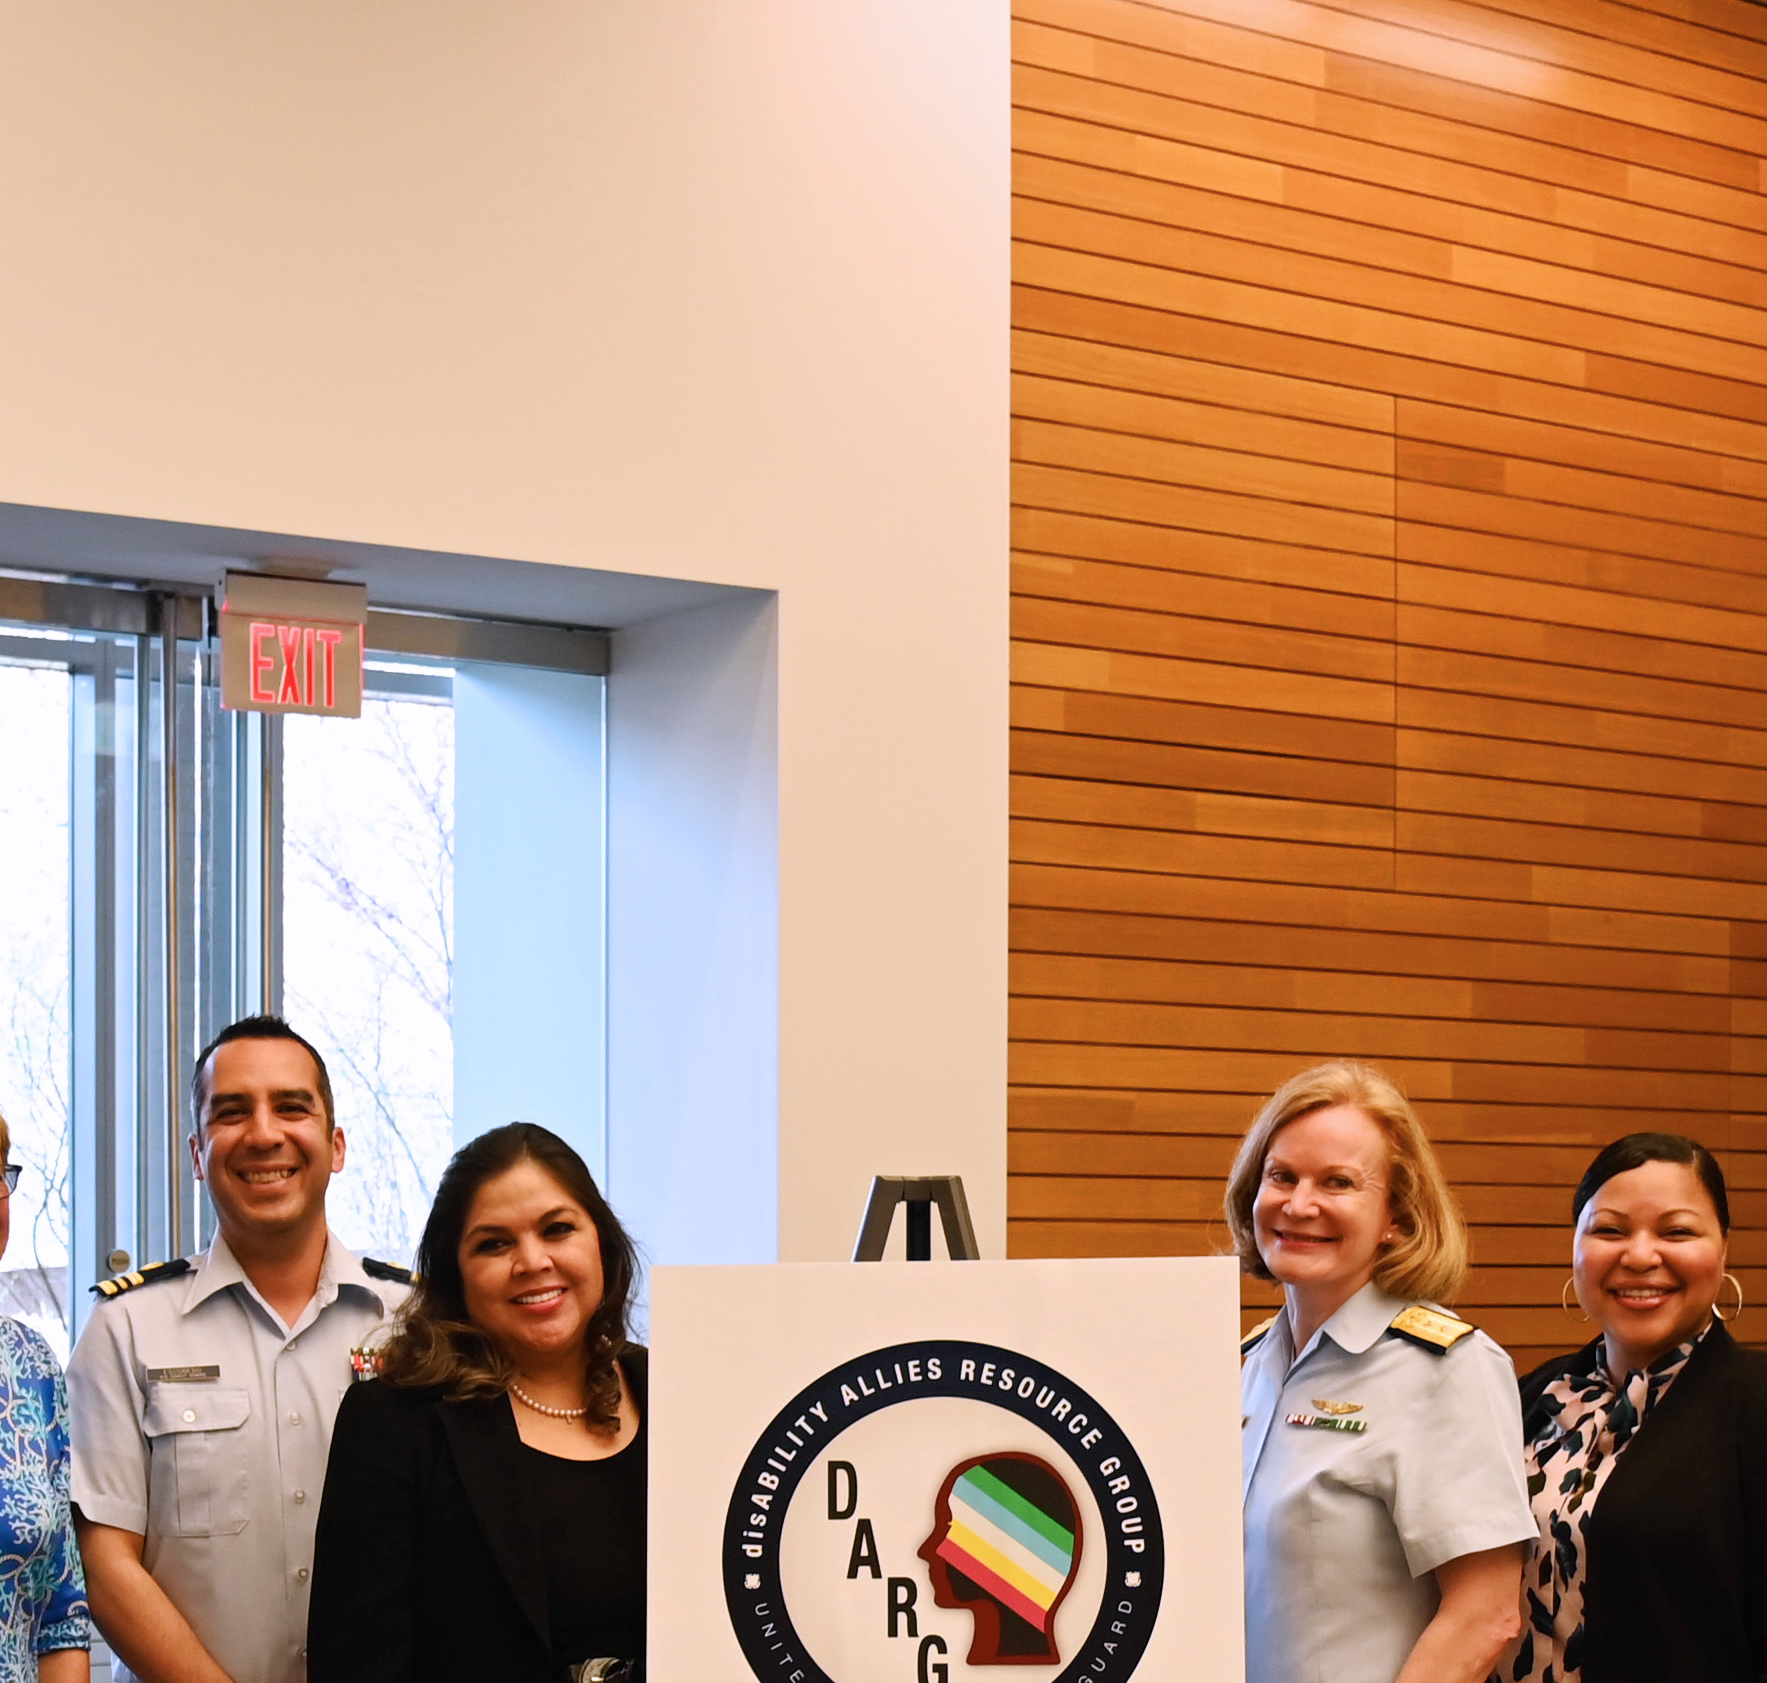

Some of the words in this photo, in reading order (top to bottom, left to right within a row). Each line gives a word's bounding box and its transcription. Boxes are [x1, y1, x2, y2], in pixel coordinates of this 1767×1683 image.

[250, 622, 342, 708] EXIT
[741, 1400, 829, 1558] disABILITY
[840, 1357, 942, 1407] ALLIES
[959, 1358, 1103, 1450] RESOURCE
[1099, 1456, 1145, 1554] GROUP
